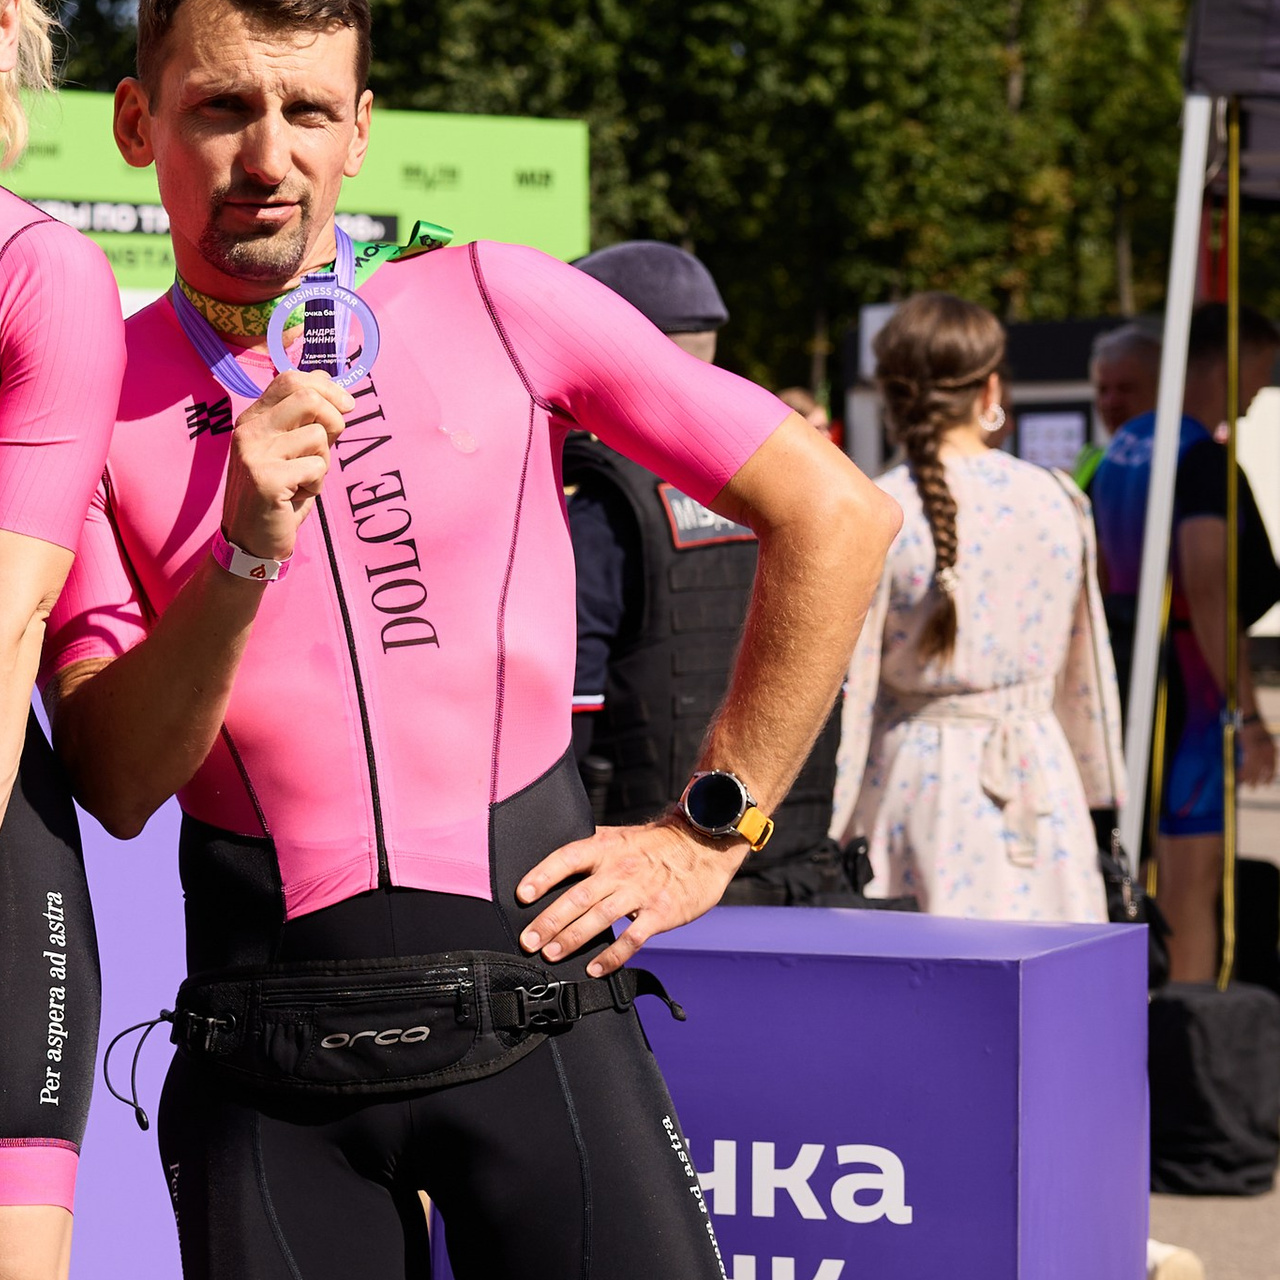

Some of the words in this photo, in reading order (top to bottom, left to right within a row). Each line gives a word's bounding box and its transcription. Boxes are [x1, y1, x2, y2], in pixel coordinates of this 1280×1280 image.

[283, 287, 332, 310] BUSINESS
[333, 288, 358, 308] STAR
[306, 328, 336, 336] АНДРЕ
[346, 469, 440, 655] DOLCE
[42, 890, 66, 948] astra
[43, 950, 67, 981] ad
[47, 985, 68, 1063] aspera
[320, 1025, 432, 1050] orca
[40, 1066, 61, 1107] Per
[661, 1114, 696, 1179] astra
[685, 1137, 913, 1225] чка
[689, 1183, 708, 1214] ad
